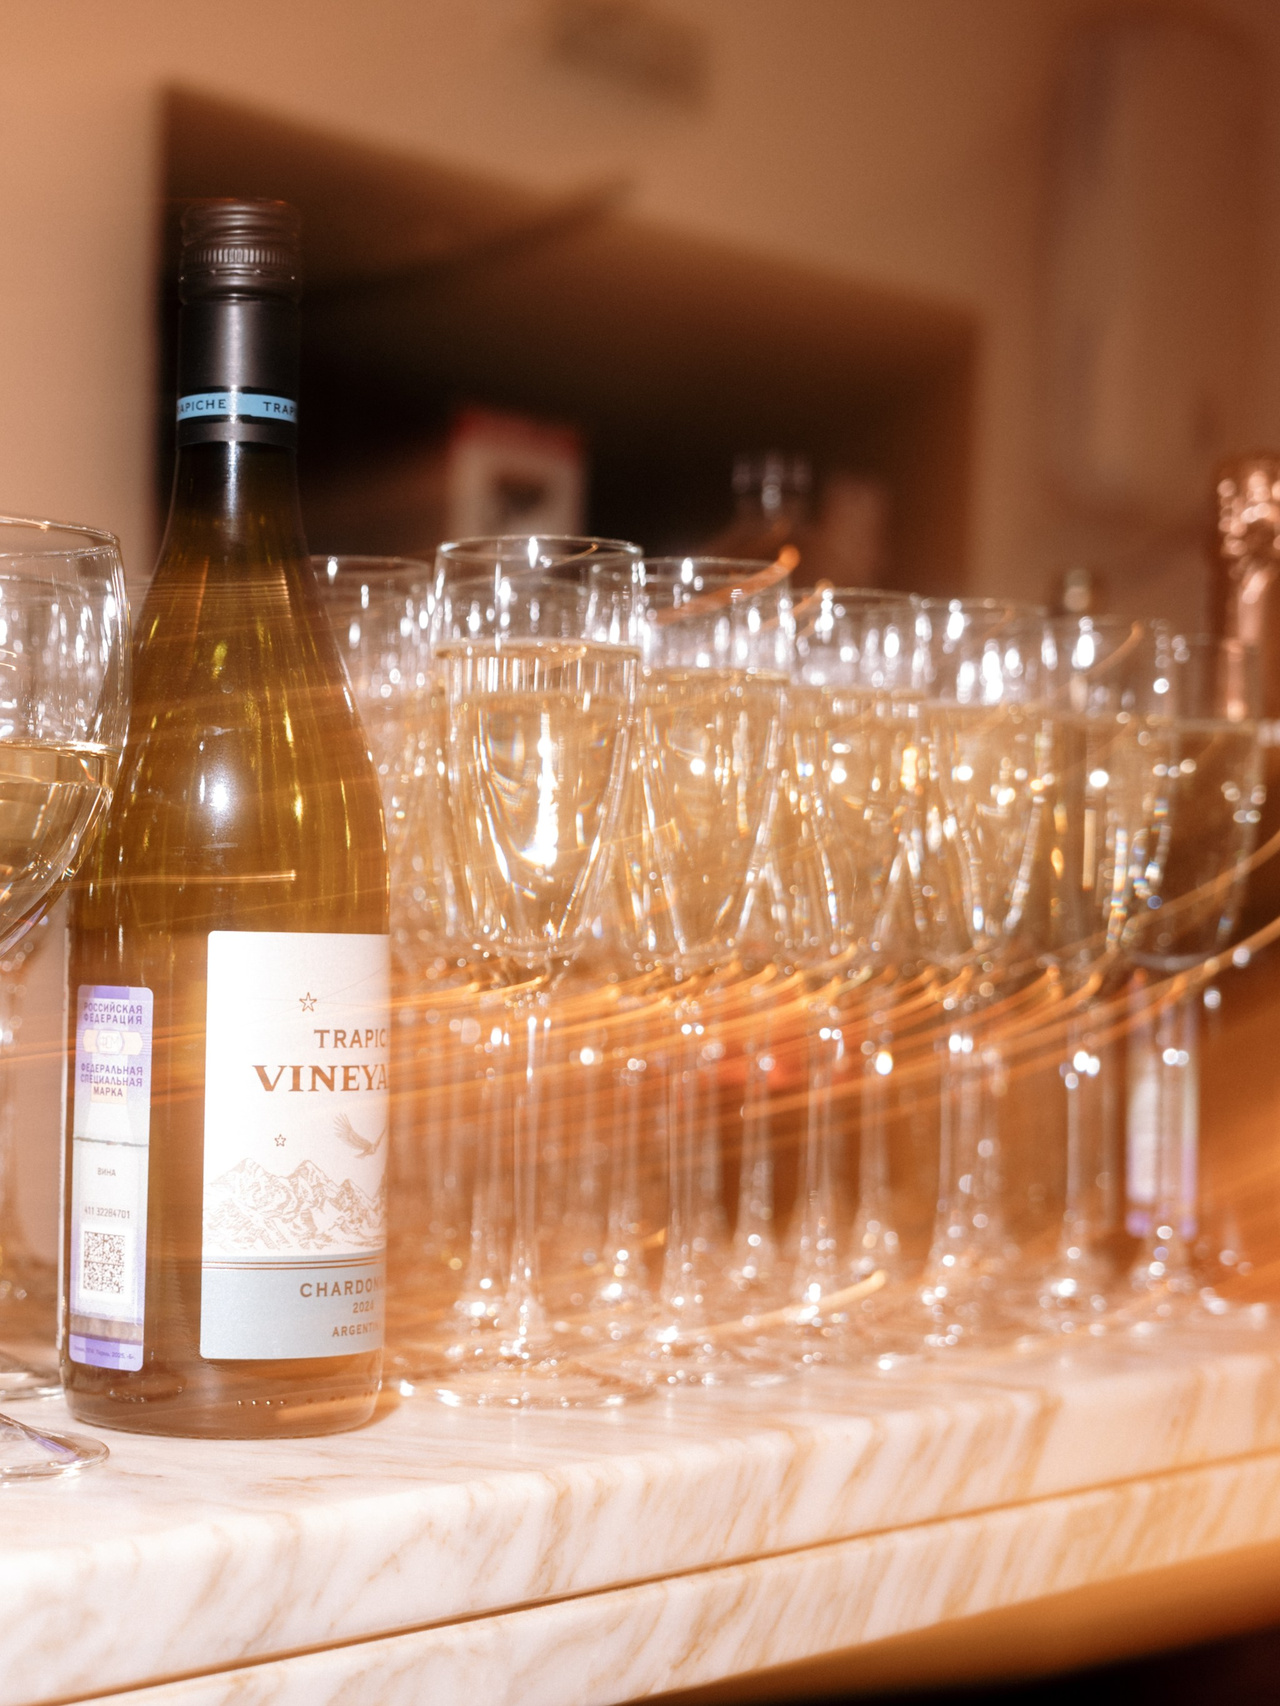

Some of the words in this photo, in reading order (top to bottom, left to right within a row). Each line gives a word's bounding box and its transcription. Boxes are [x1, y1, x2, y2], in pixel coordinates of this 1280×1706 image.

[179, 399, 227, 413] APICHE
[84, 1002, 143, 1014] РОССИЙСКАЯ
[83, 1013, 143, 1025] ФЕДЕРАЦИЯ
[81, 1063, 143, 1076] ФЕДЕРАЛЬНАЯ
[80, 1074, 143, 1087] СПЕЦИАЛЬНАЯ
[252, 1063, 389, 1092] VINEYA
[93, 1086, 123, 1097] МАРКА
[97, 1167, 116, 1177] ВИНА
[300, 1276, 382, 1298] CHARDON
